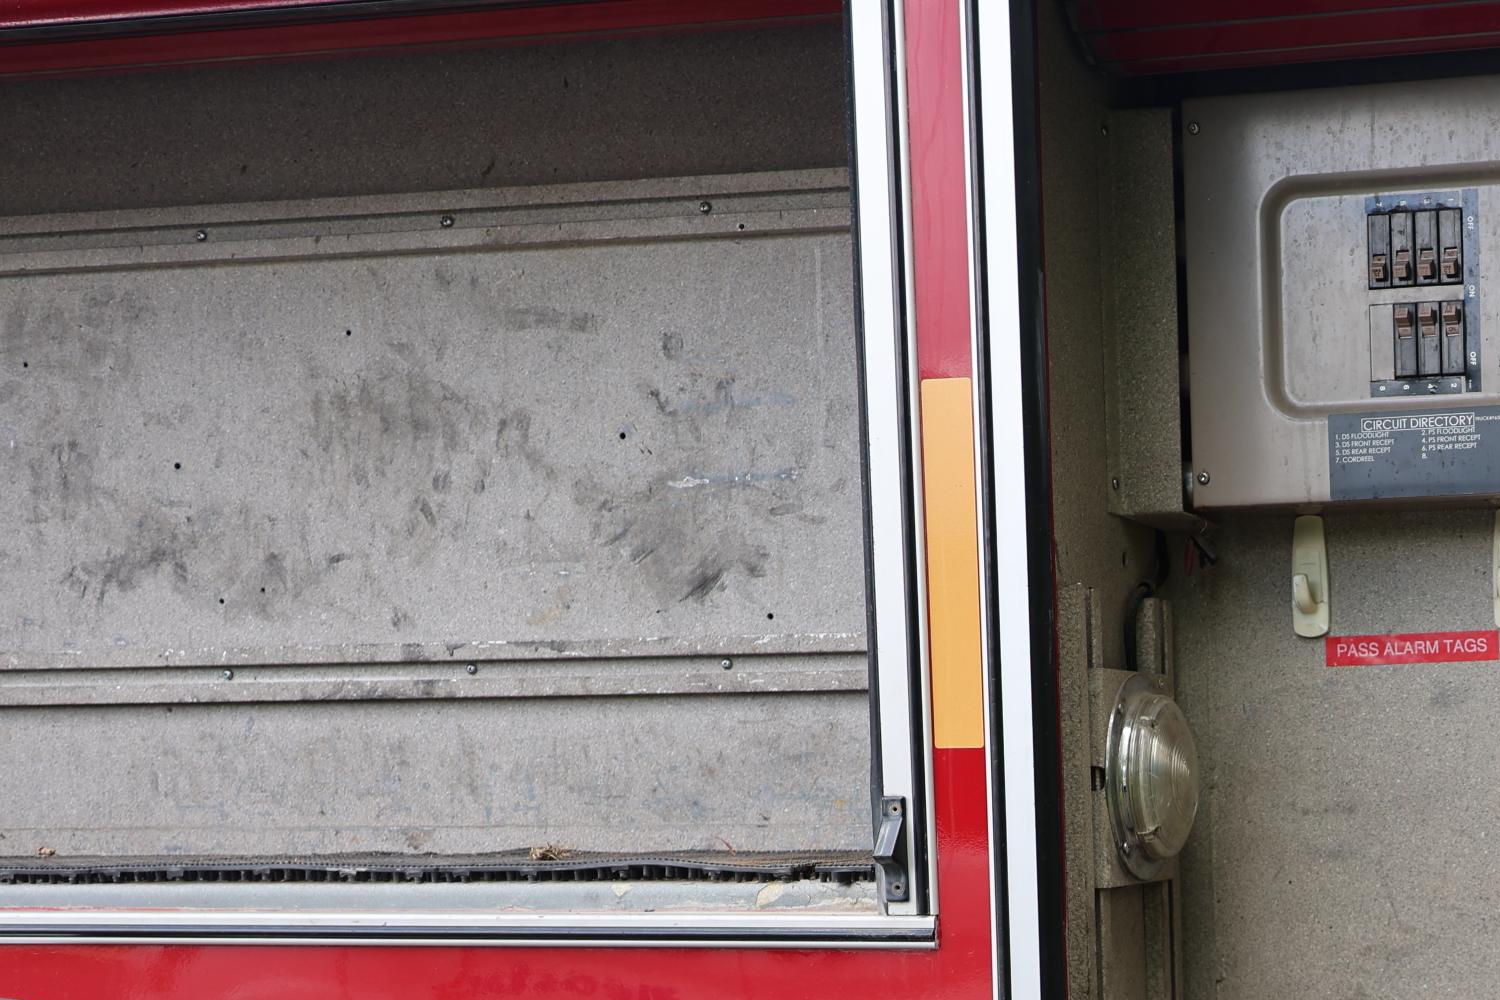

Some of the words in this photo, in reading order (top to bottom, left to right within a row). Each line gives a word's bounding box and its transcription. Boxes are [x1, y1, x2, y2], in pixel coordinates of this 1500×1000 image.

[1468, 285, 1475, 297] ON
[1363, 419, 1407, 430] CIRCUIT
[1410, 415, 1473, 428] DIRECTORY
[1436, 427, 1475, 435] FLOODLIGHT
[1336, 643, 1379, 657] PASS
[1384, 640, 1439, 656] ALARM
[1443, 638, 1488, 653] TAGS
